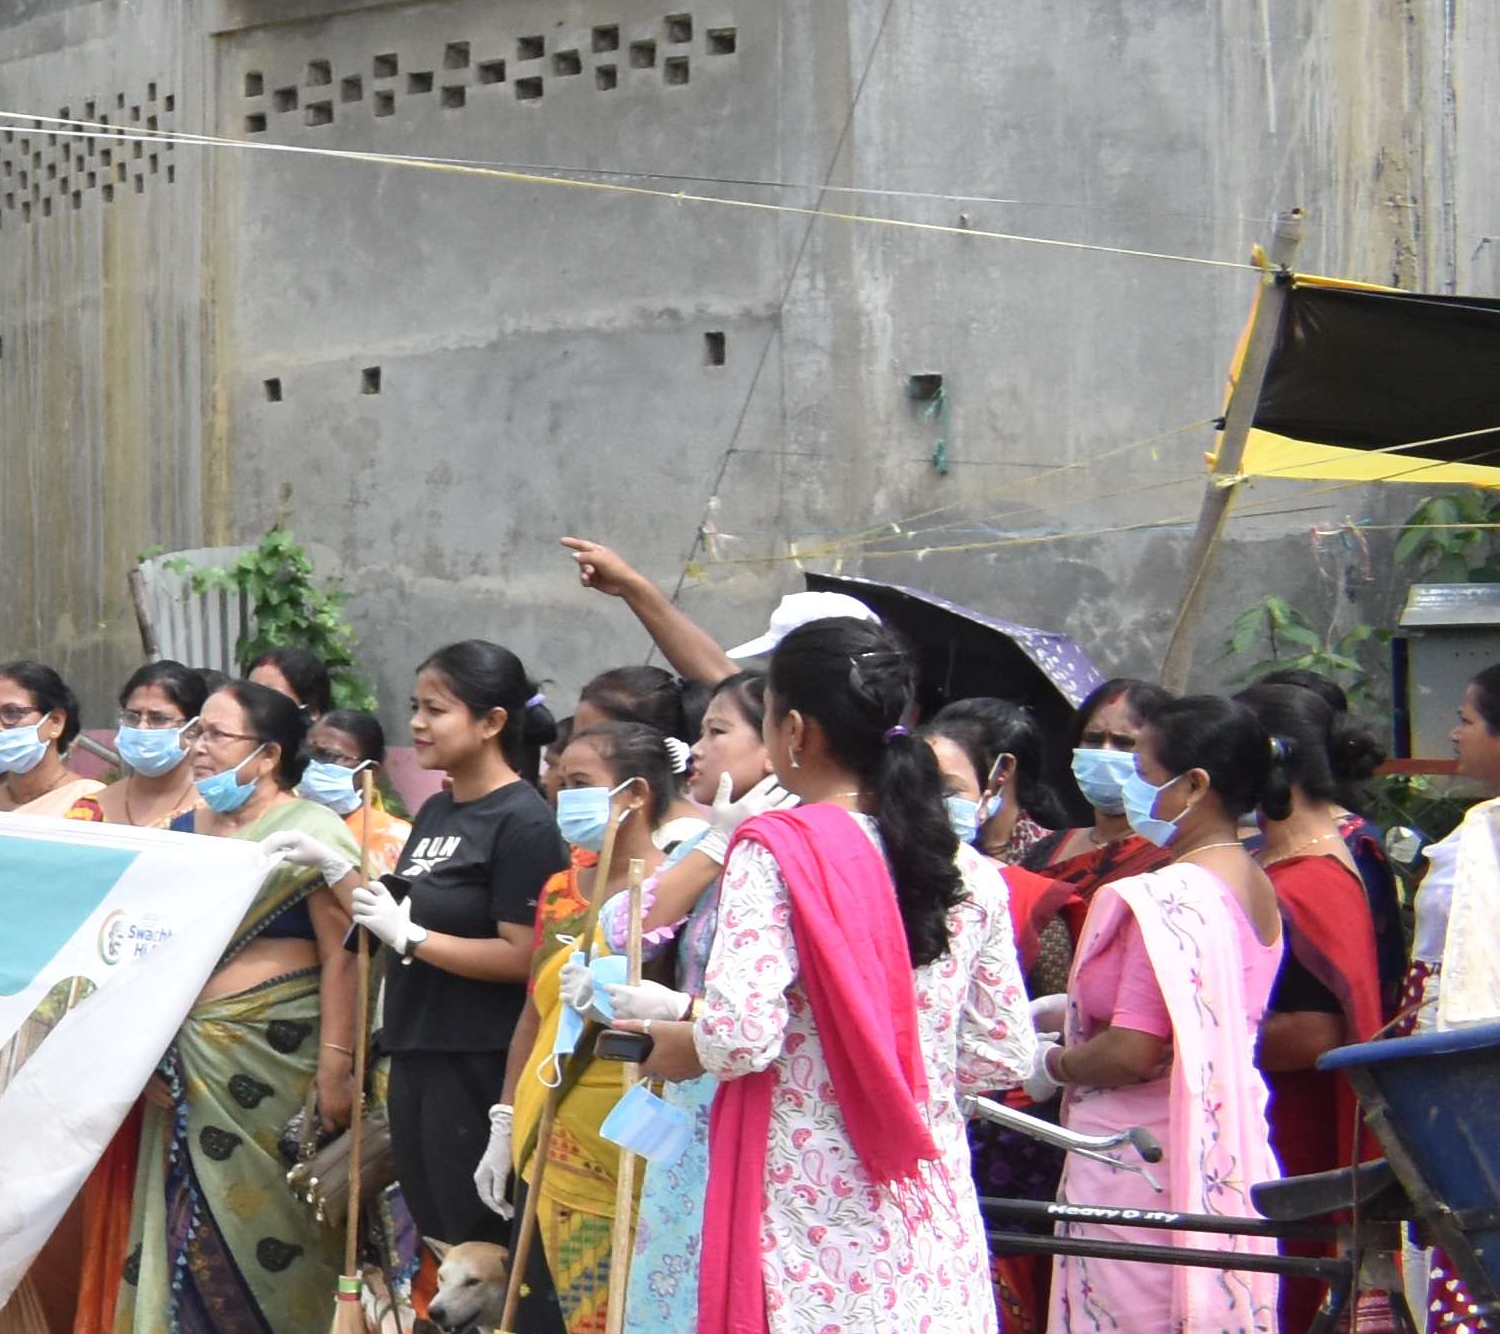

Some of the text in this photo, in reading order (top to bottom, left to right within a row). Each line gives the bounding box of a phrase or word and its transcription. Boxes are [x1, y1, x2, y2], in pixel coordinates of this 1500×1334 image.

[411, 836, 462, 857] RUN
[1047, 1203, 1180, 1223] Heavy Dty
